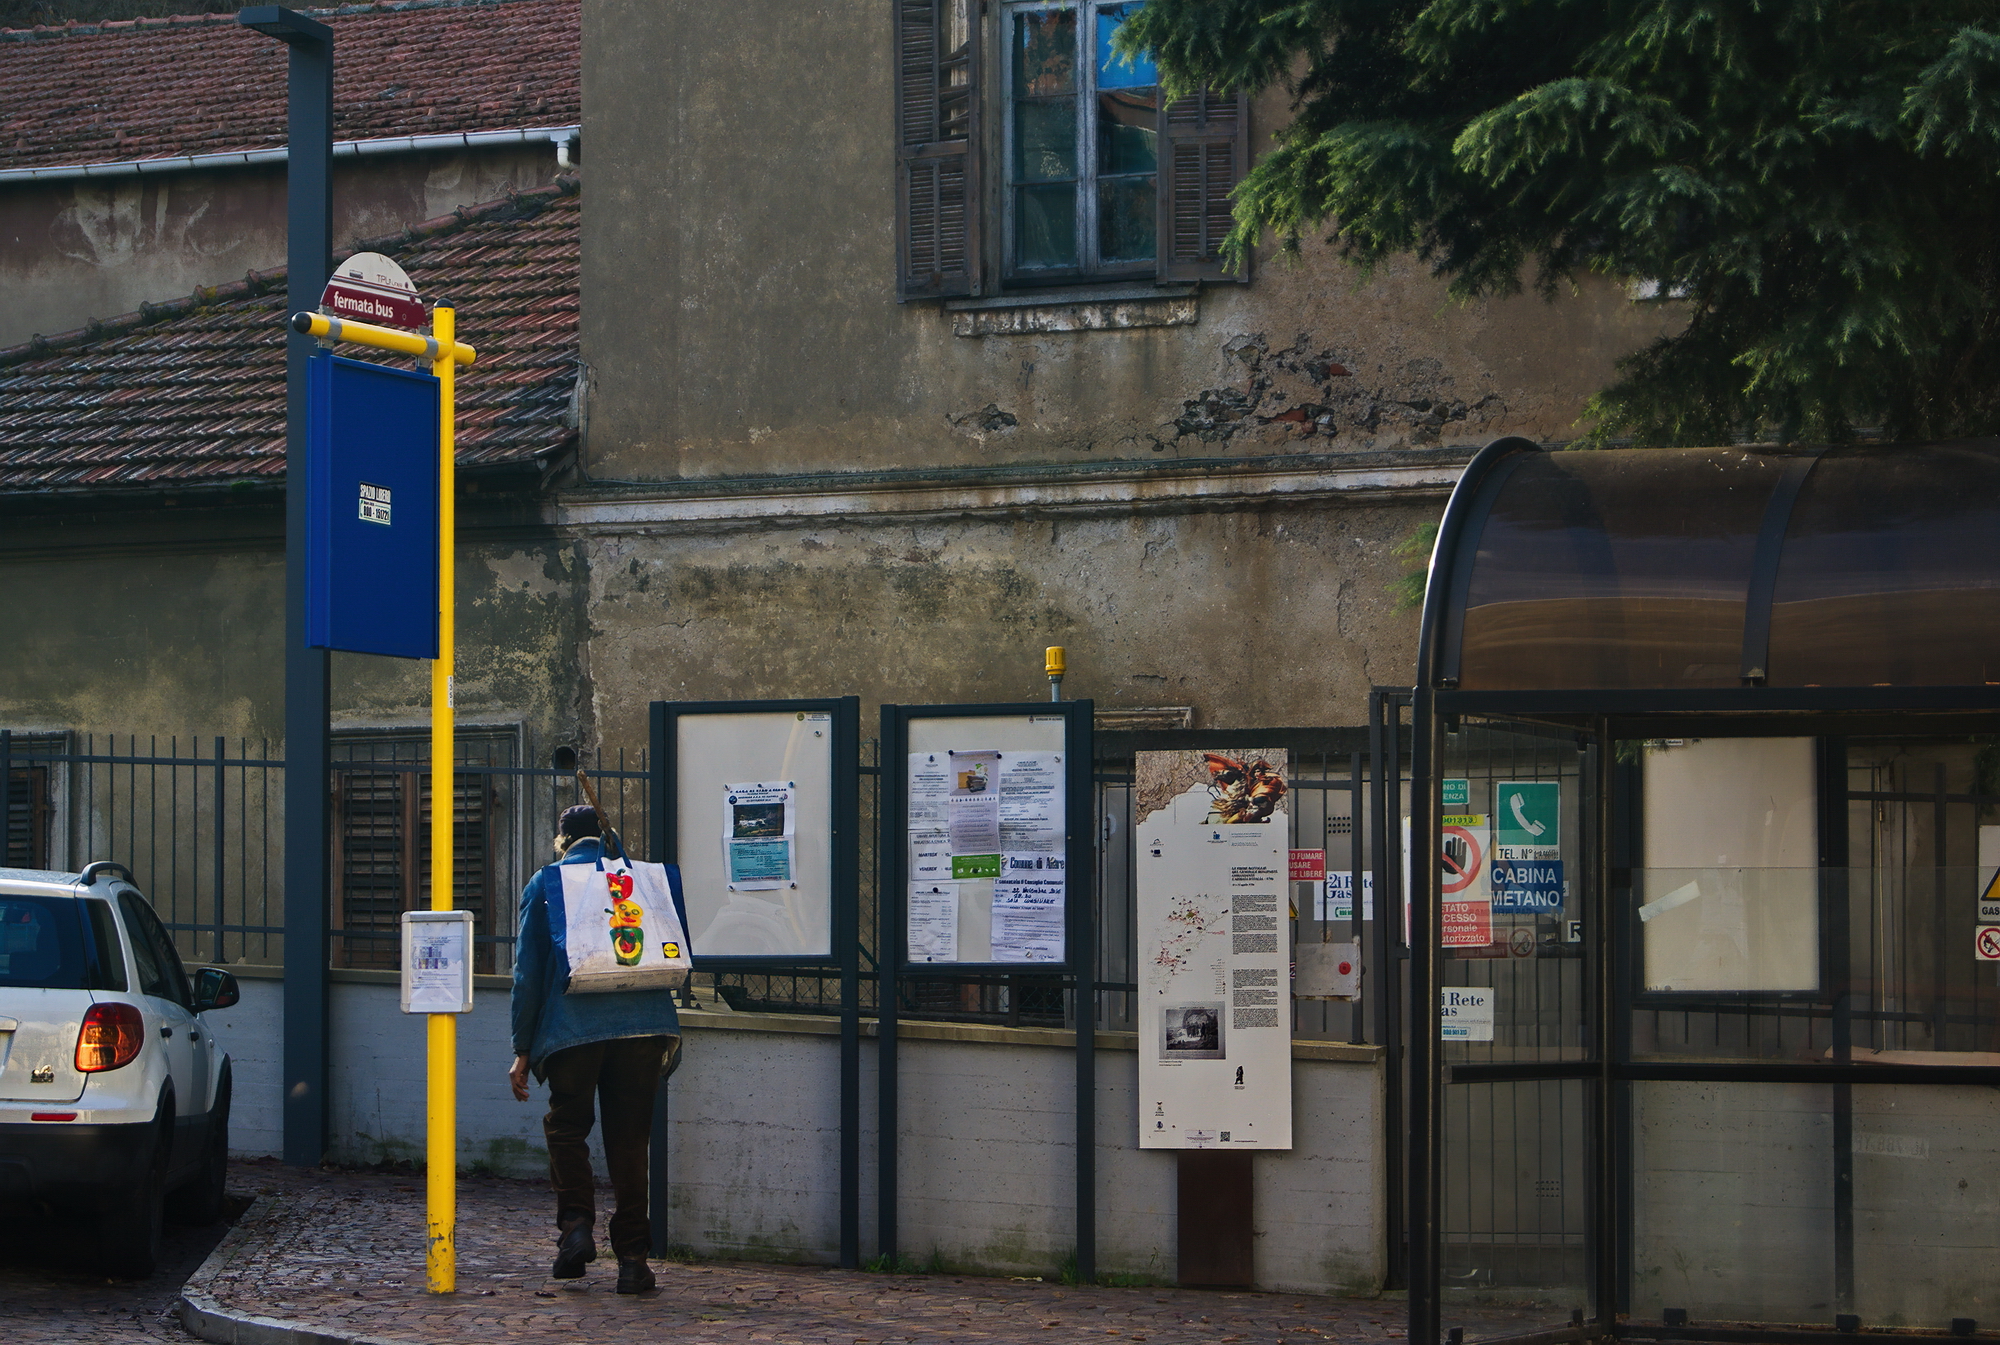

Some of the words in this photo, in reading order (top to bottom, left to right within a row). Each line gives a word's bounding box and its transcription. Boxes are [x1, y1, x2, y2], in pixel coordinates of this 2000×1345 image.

[334, 291, 373, 314] fermata
[375, 299, 393, 318] bus
[1297, 852, 1323, 860] FUMARE
[1498, 848, 1518, 859] TEL.
[1290, 861, 1311, 869] USARE
[1300, 870, 1323, 878] LIBERE
[1492, 867, 1557, 884] CABINA
[1491, 890, 1560, 907] METANO
[1981, 906, 2000, 916] GAS
[1449, 991, 1485, 1006] Rete
[1441, 1006, 1459, 1017] as
